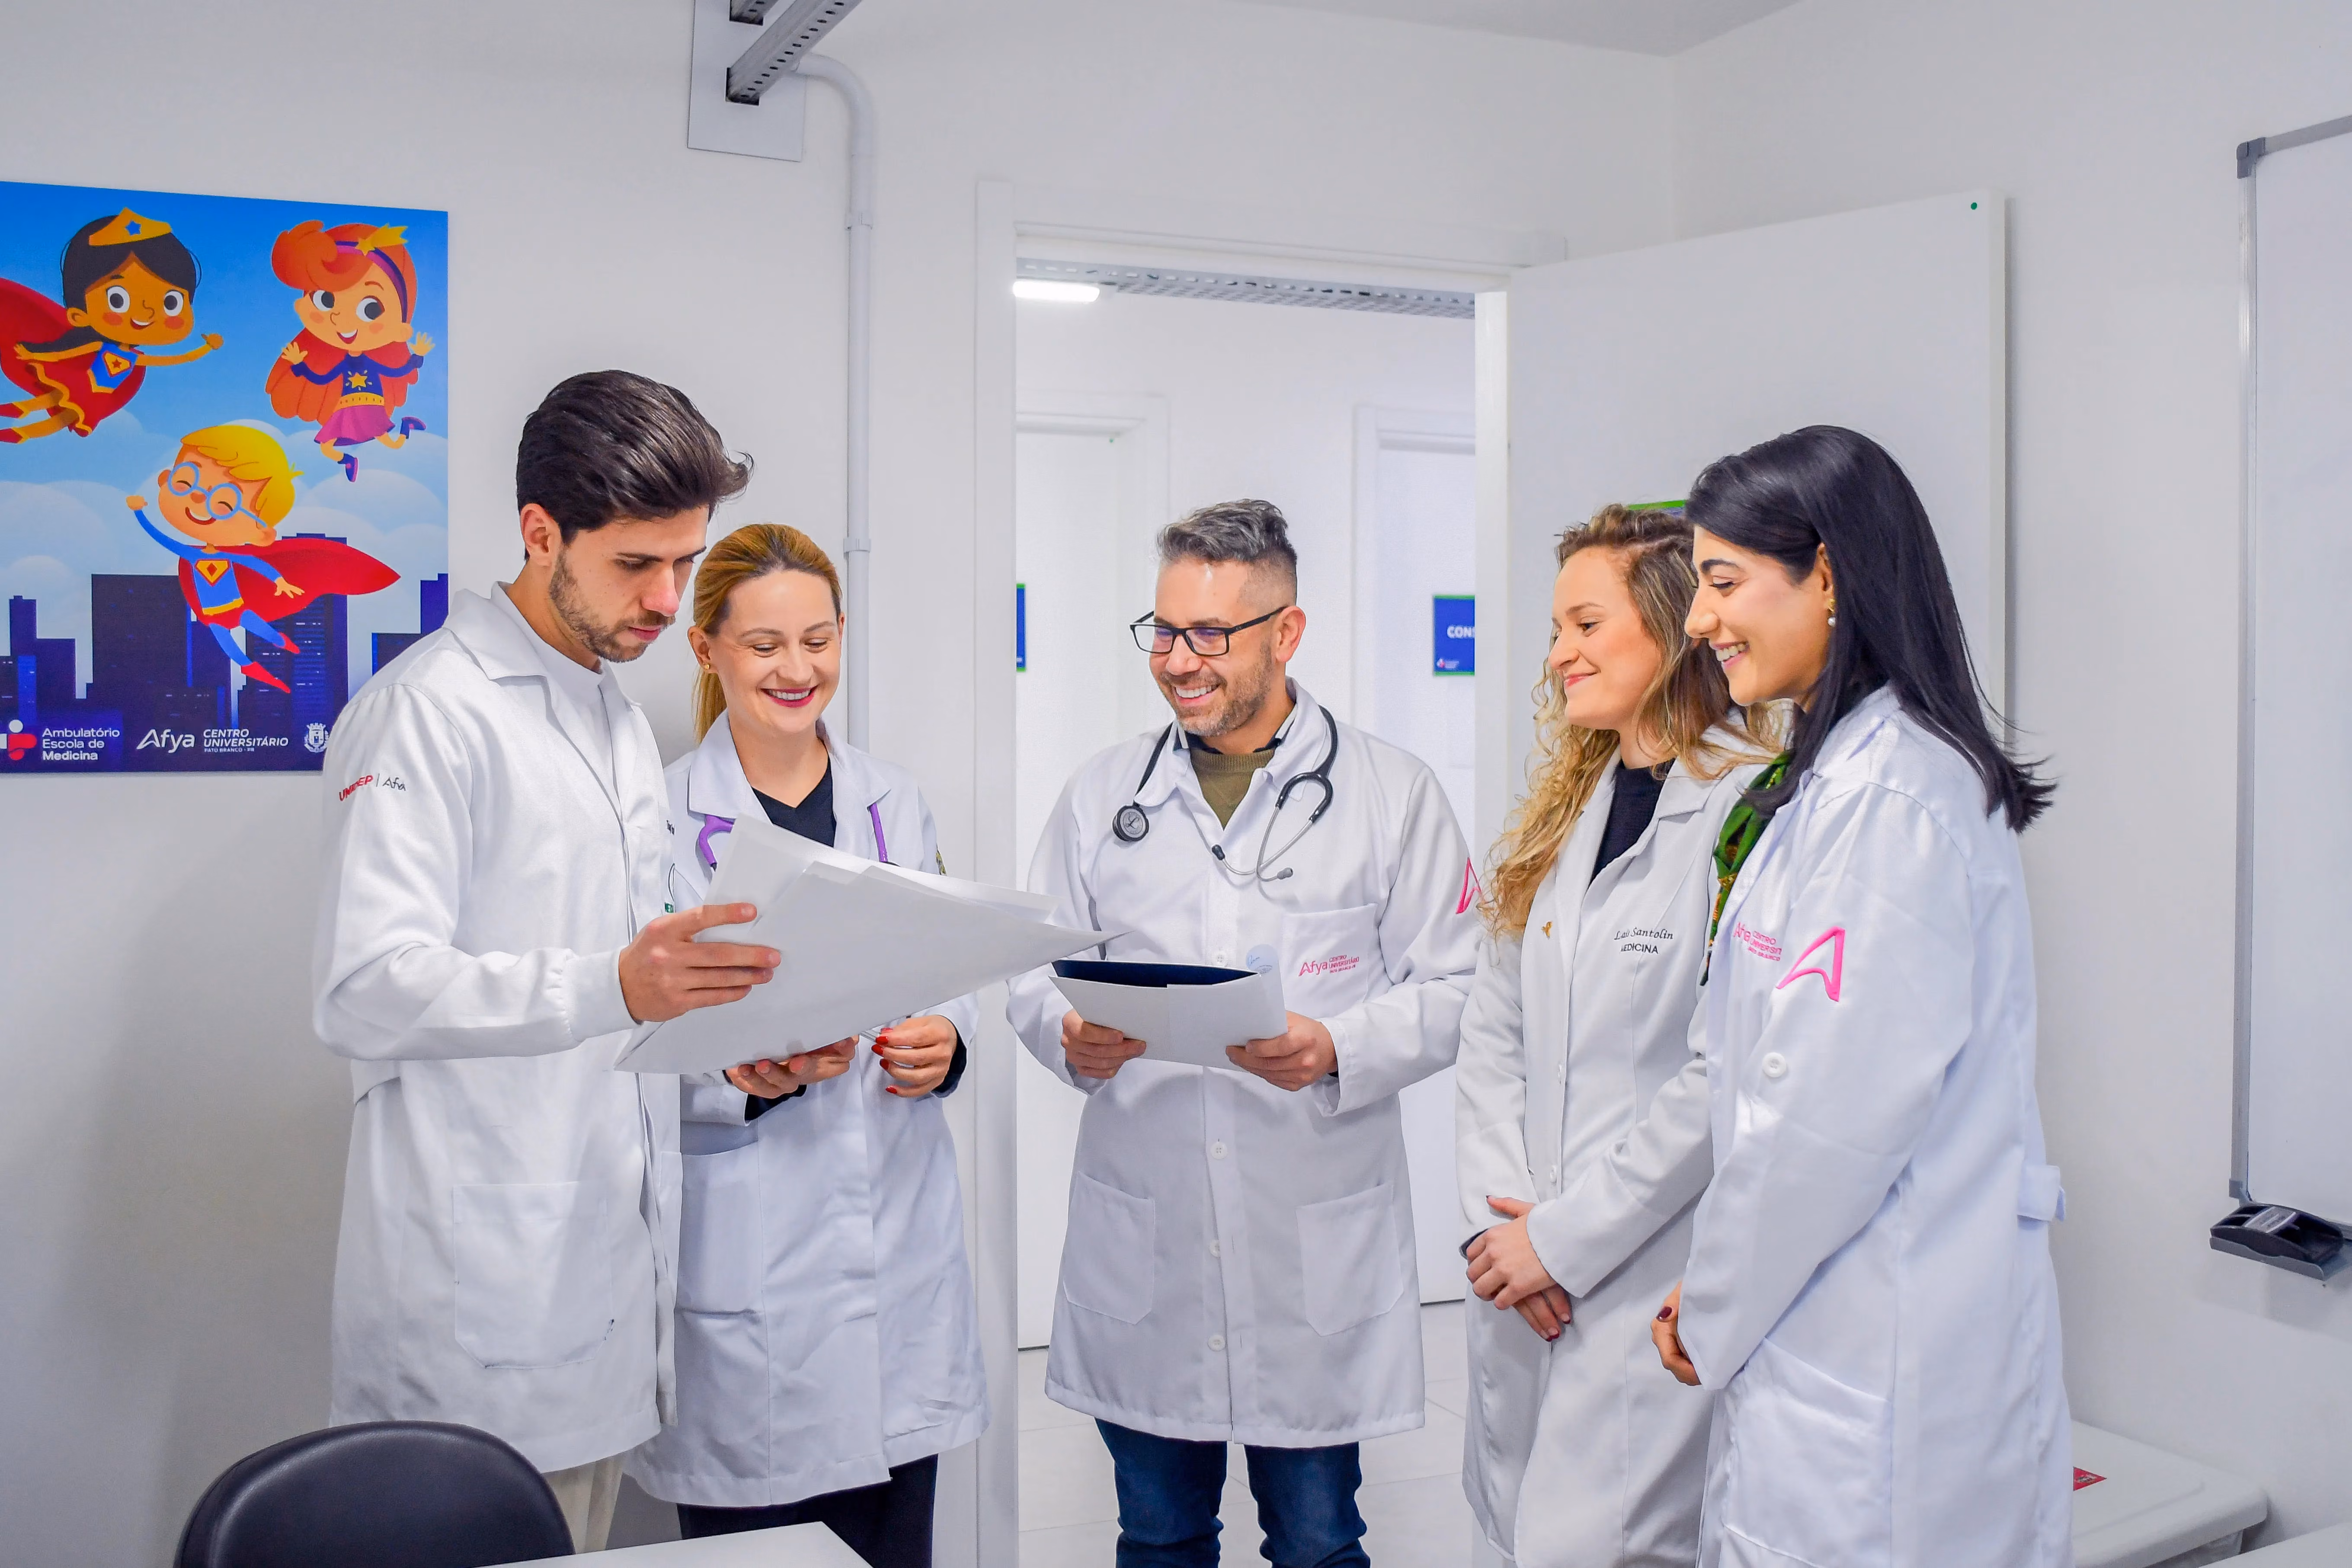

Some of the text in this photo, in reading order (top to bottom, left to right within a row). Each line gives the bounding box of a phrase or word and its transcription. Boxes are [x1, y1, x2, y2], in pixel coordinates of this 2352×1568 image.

[42, 728, 120, 737] Ambulatório
[203, 729, 249, 738] CENTRO
[42, 739, 105, 749] Escola de
[136, 729, 195, 753] Afya
[204, 736, 288, 747] UNIVERSITÁRIO
[43, 751, 98, 761] Medicina
[339, 775, 374, 801] UNEP
[1631, 927, 1673, 940] Santolin
[1298, 960, 1328, 977] Afya
